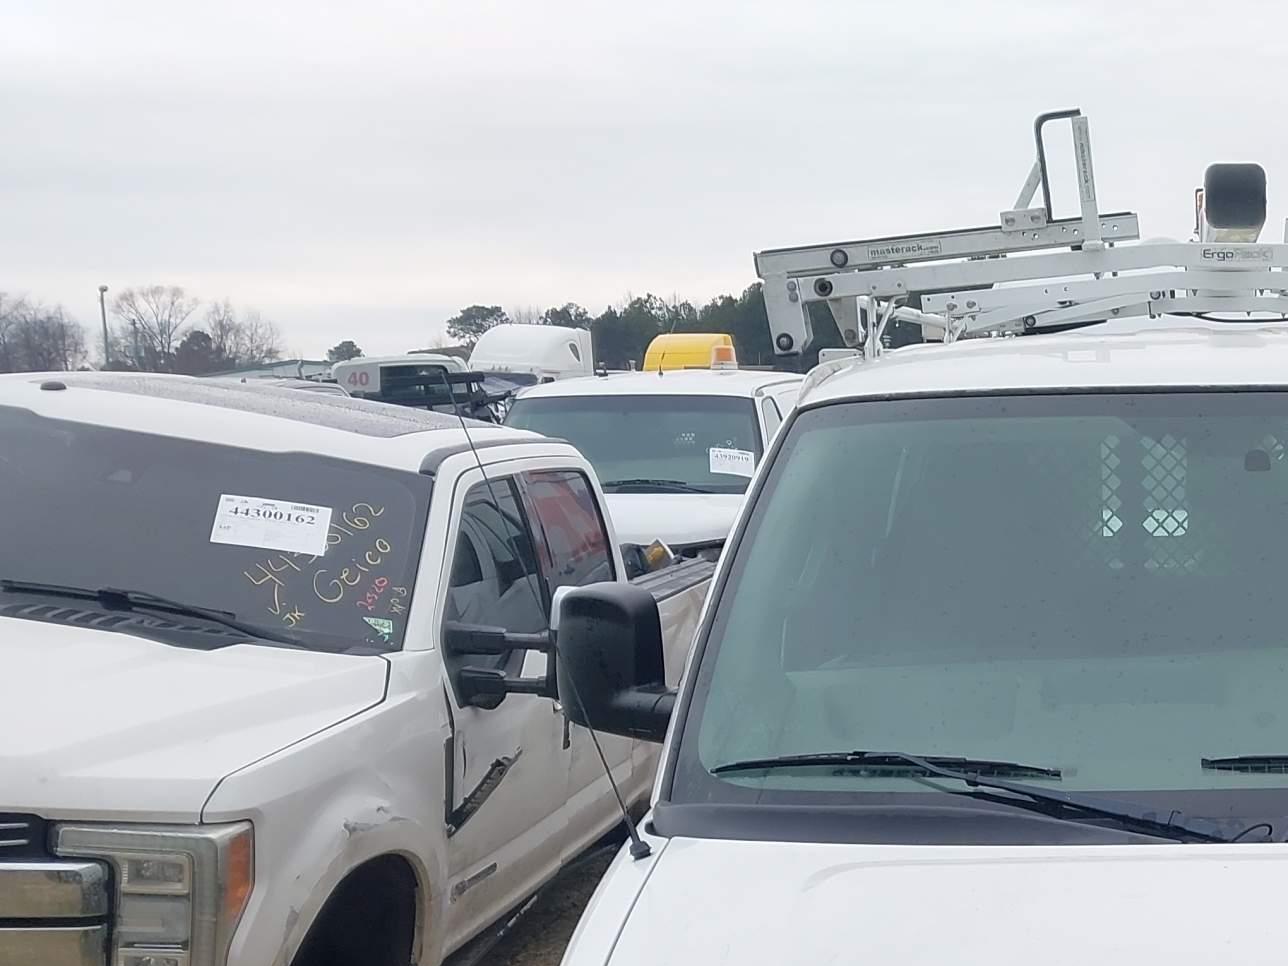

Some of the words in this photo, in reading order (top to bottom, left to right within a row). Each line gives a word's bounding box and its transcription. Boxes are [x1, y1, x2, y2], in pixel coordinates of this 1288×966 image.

[347, 371, 369, 386] 40
[229, 506, 316, 525] 44300162
[313, 538, 391, 603] Geico
